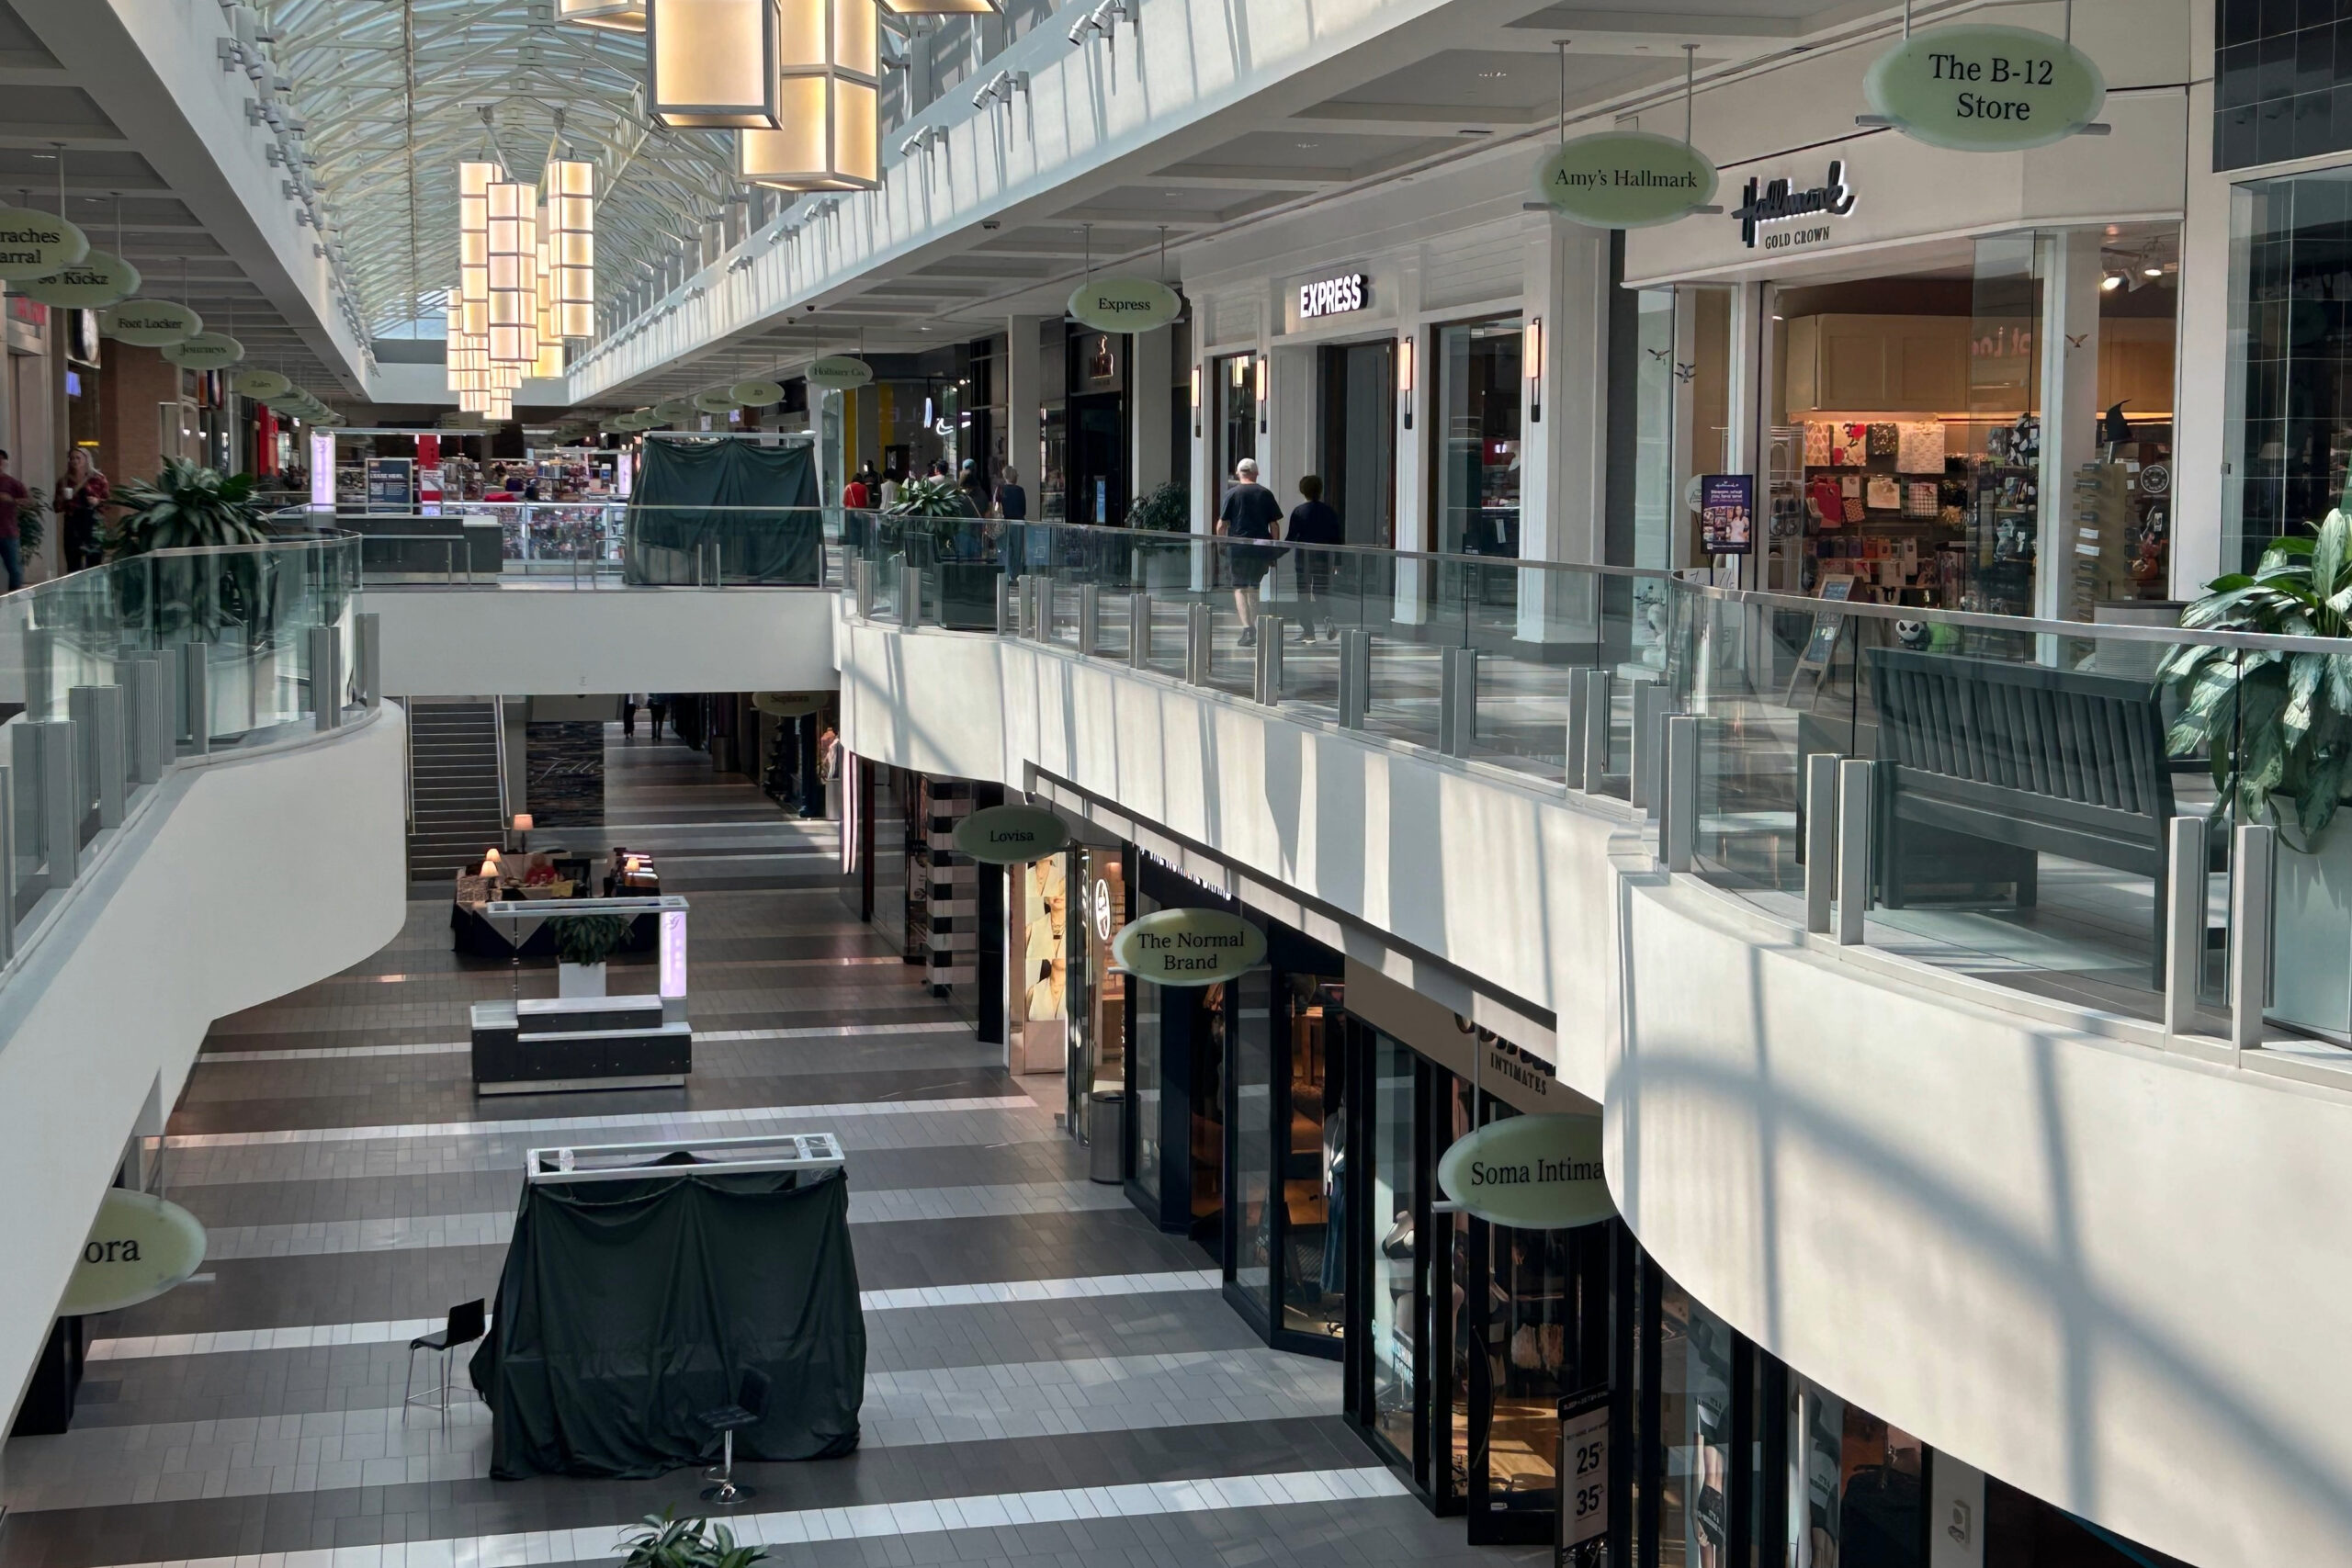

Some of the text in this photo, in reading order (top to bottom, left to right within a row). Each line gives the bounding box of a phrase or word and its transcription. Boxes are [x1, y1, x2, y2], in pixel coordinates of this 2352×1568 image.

[1928, 53, 2052, 85] The B-12
[1957, 93, 2030, 120] Store
[1555, 169, 1698, 191] Amy's Hallmark
[1731, 160, 1856, 249] Hallmark
[1765, 226, 1830, 250] GOLD CROWN
[1098, 298, 1151, 313] Express
[1300, 273, 1364, 319] EXPRESS
[118, 318, 183, 330] Foot Locker
[178, 344, 227, 356] Journeys
[814, 367, 847, 376] Hollister
[990, 829, 1035, 842] Lovisa
[1137, 931, 1244, 949] The Normal
[1164, 954, 1217, 970] Brand
[1490, 1052, 1546, 1096] INTIMATES
[1471, 1161, 1531, 1186] Soma
